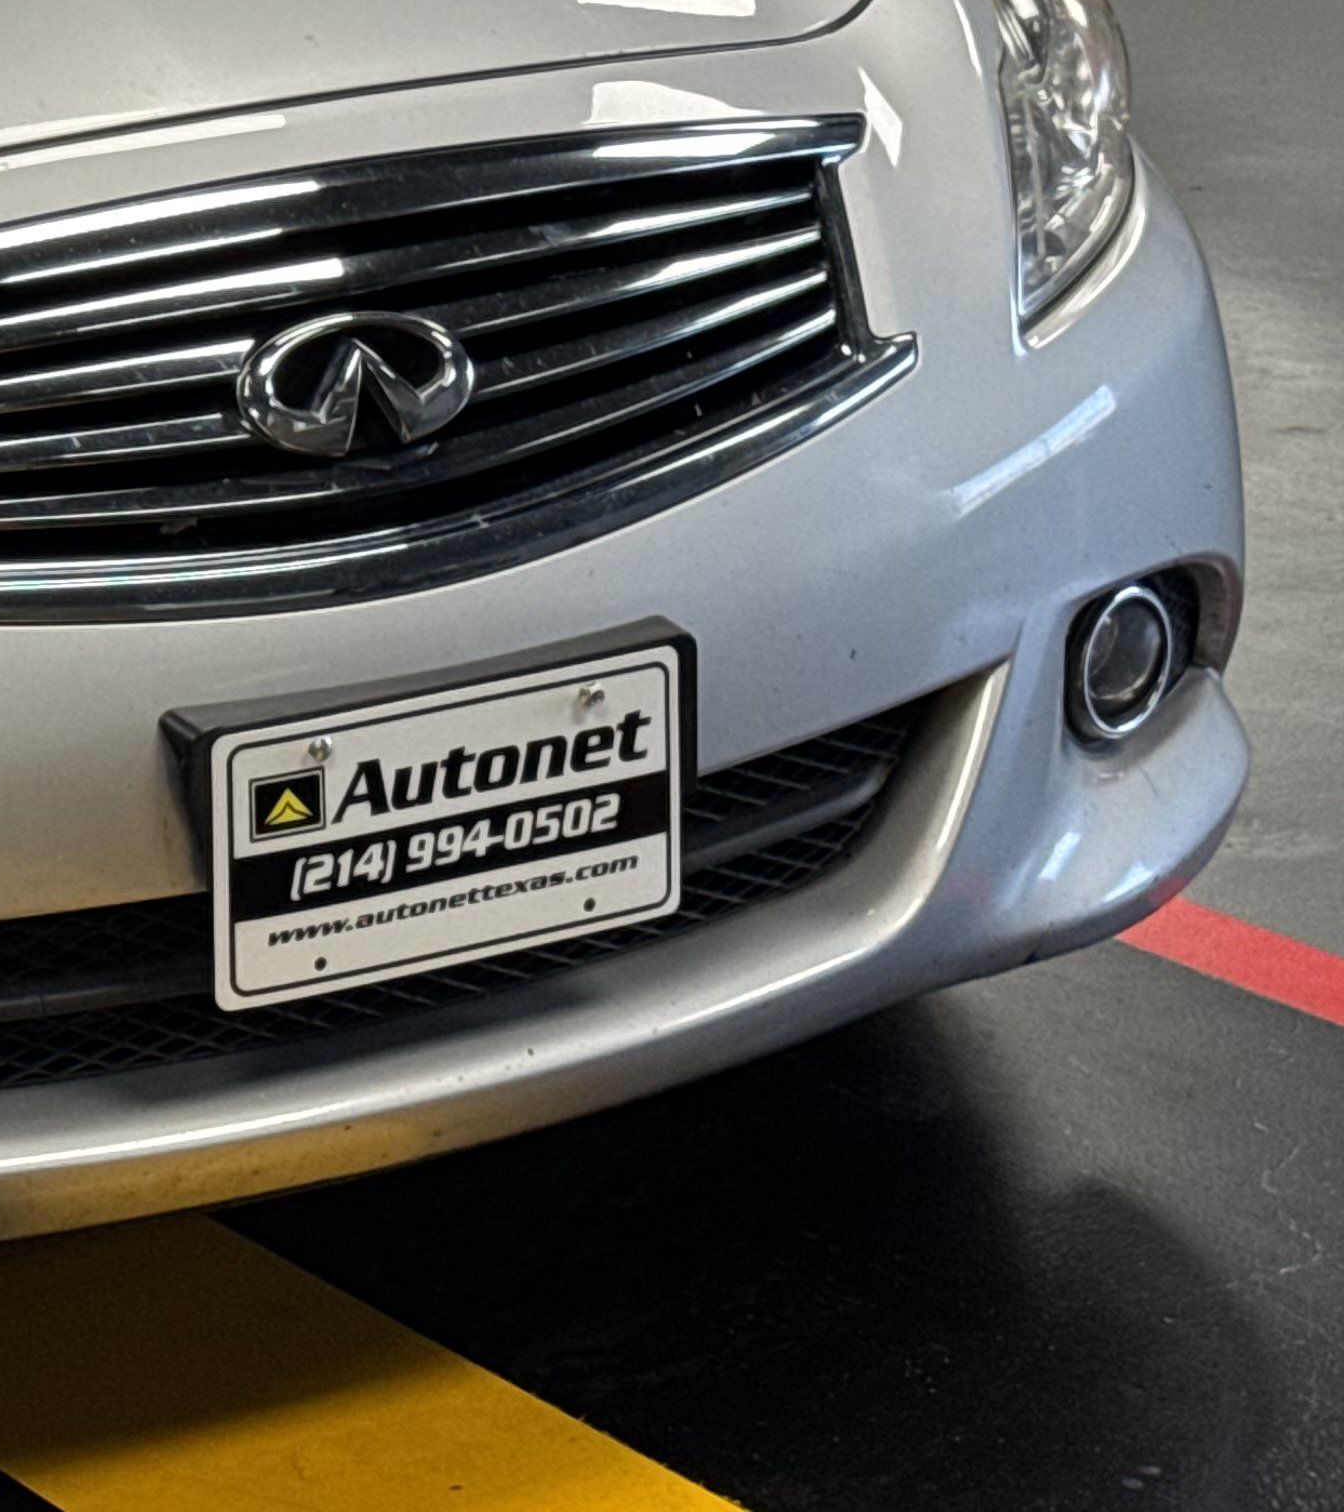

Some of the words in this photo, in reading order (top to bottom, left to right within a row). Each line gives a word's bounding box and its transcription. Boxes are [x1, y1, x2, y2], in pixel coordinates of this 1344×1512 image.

[333, 710, 652, 824] Autonet
[267, 854, 639, 946] www.autonettexas.com
[291, 843, 396, 901] (214)
[406, 793, 620, 872] 994-0502
